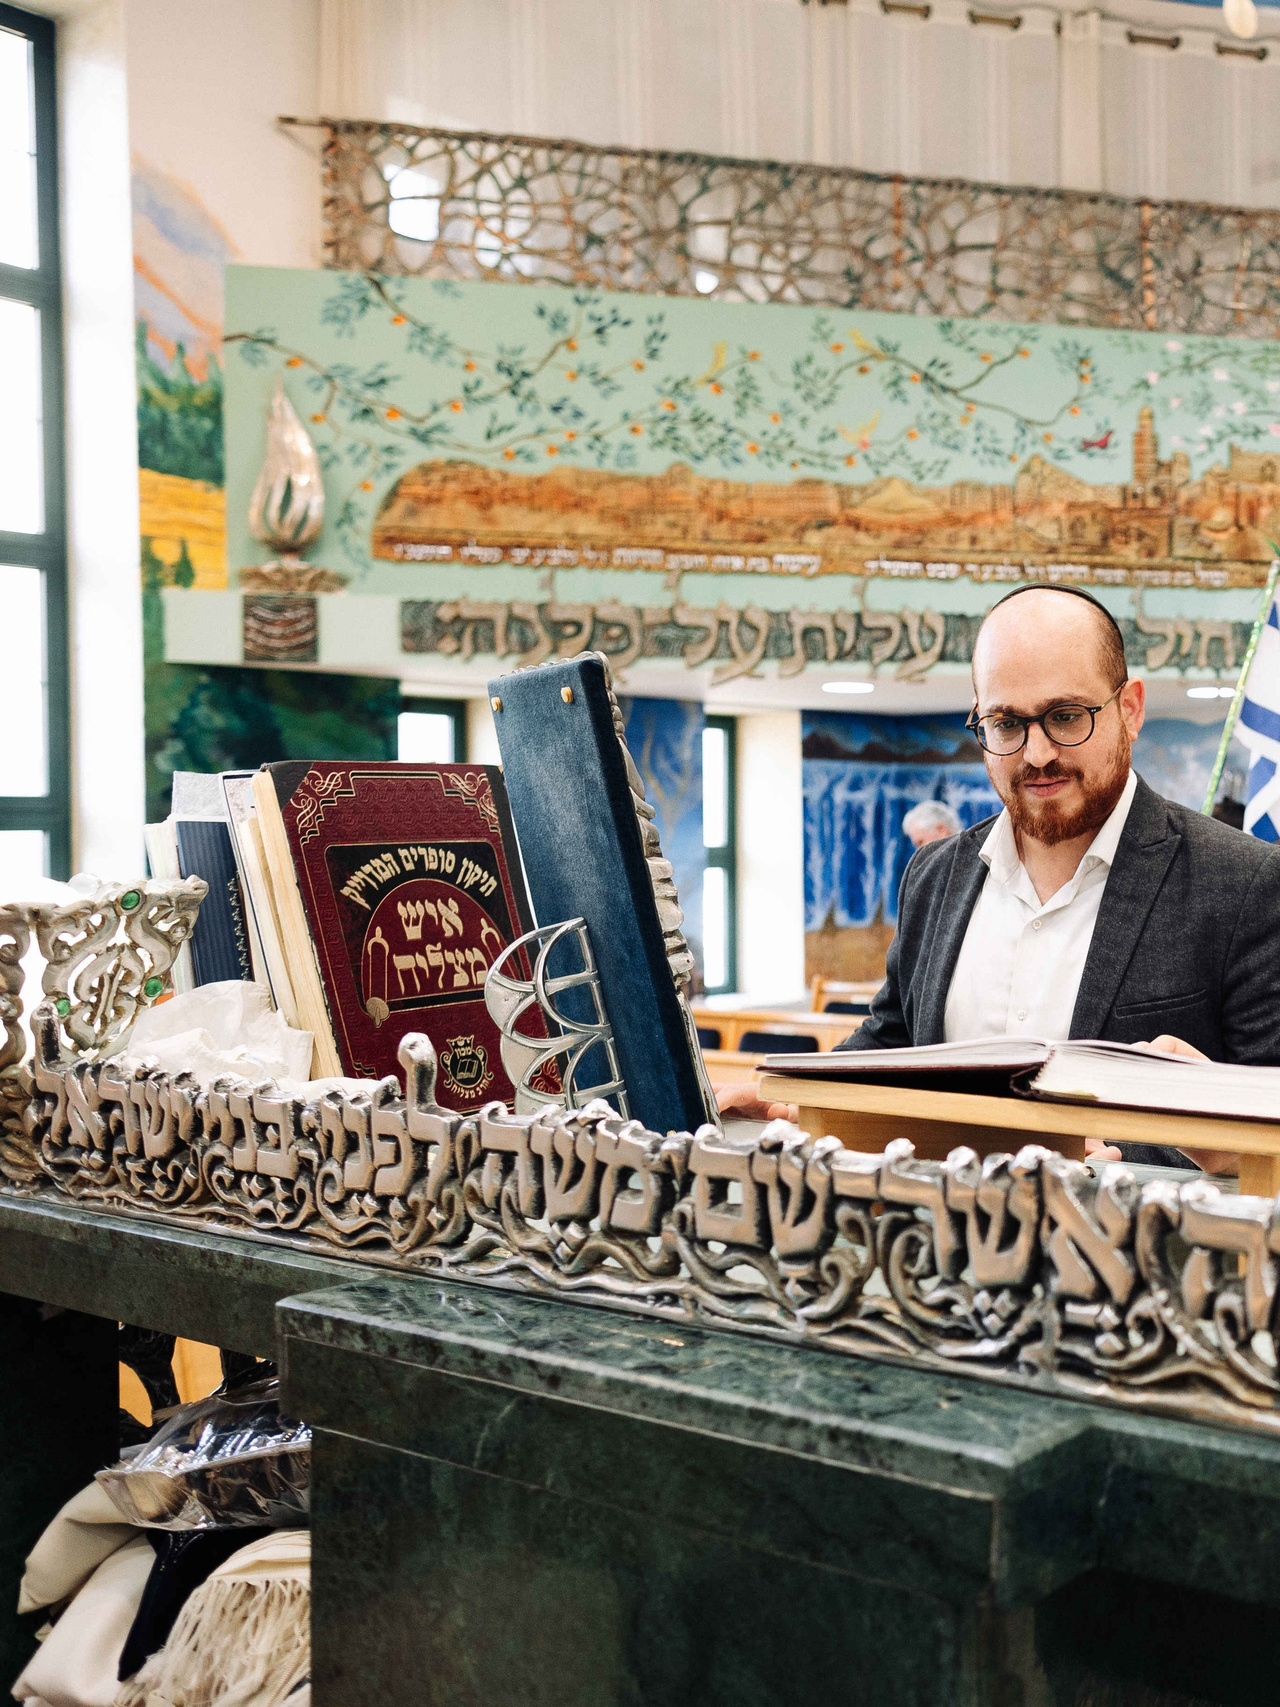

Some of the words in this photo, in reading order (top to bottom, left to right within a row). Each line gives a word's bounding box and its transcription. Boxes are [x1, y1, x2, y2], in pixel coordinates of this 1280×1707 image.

[397, 845, 456, 874] סופרים
[456, 856, 498, 897] תיקון
[339, 851, 401, 911] המדוייק
[397, 897, 464, 941] איש
[392, 941, 489, 996] מצליח
[454, 1046, 472, 1059] מכון
[450, 1083, 476, 1099] מצליח
[475, 1079, 490, 1096] הרב
[205, 1072, 302, 1181] בני
[479, 1102, 664, 1236] משה
